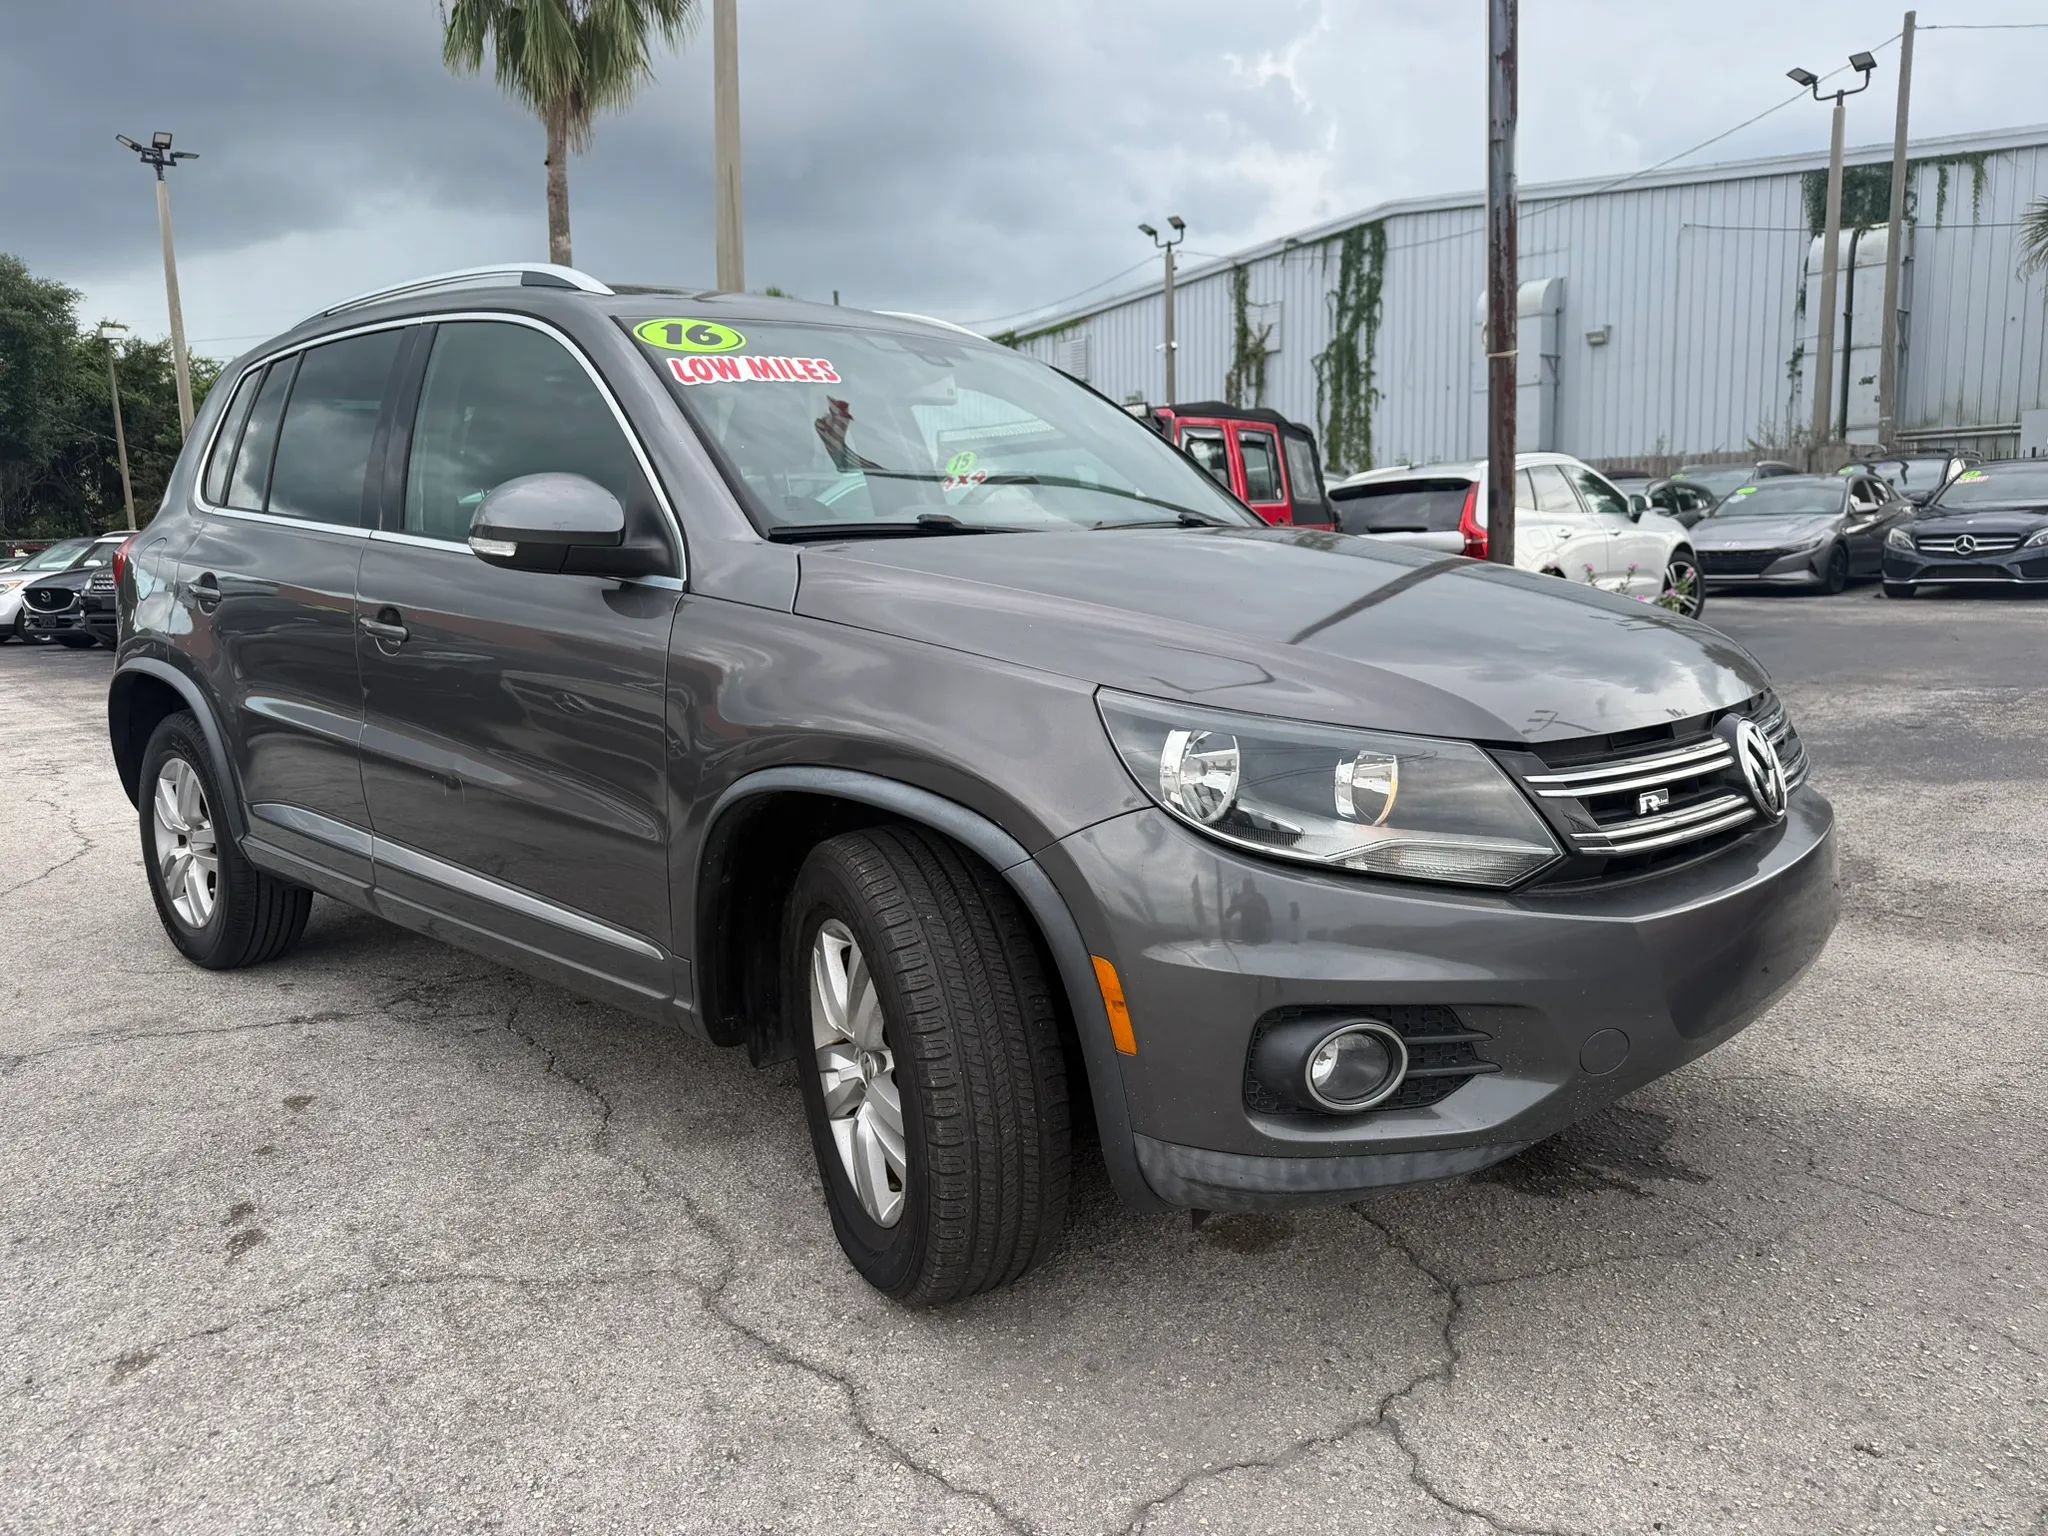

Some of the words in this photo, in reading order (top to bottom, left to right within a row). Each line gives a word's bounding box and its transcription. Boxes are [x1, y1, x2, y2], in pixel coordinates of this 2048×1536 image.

[660, 323, 724, 346] 16
[671, 357, 740, 383] LOW
[749, 357, 840, 382] MILES
